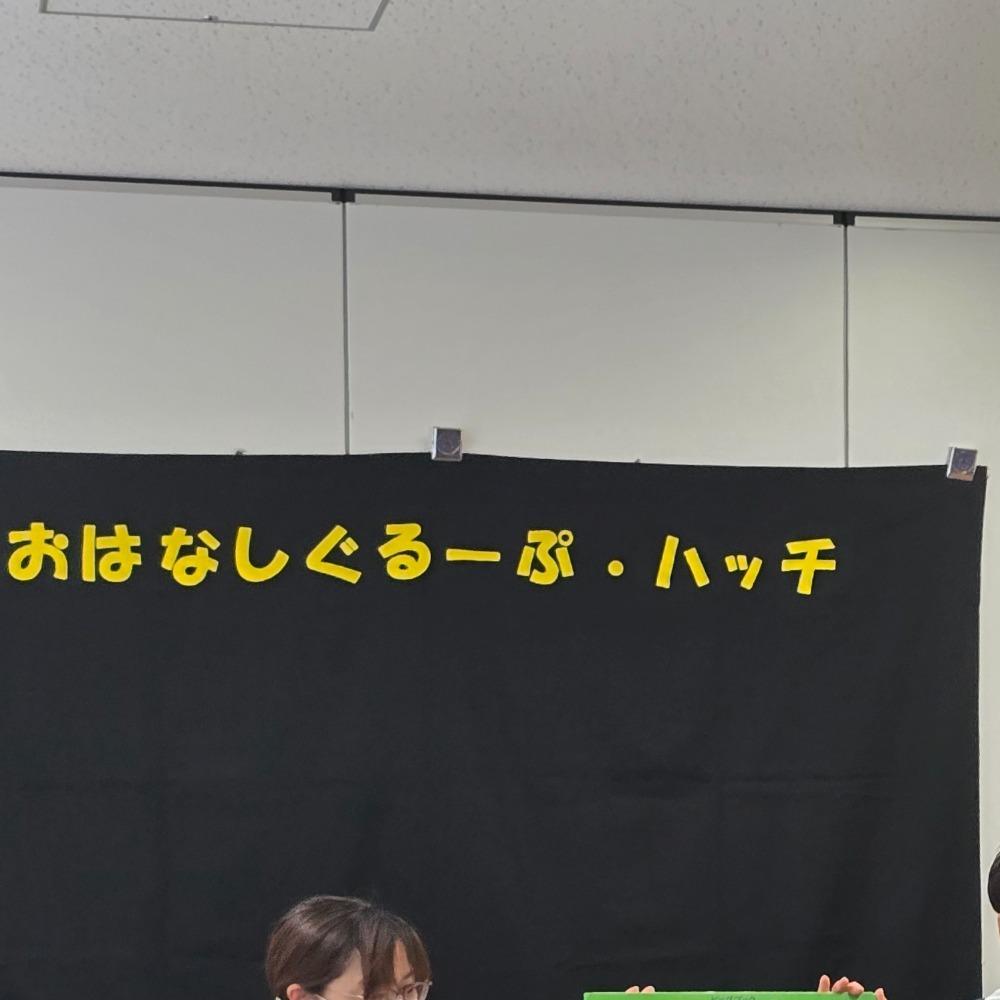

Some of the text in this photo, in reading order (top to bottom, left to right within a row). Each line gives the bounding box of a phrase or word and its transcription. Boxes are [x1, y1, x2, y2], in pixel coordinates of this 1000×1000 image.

[8, 522, 836, 595] おはなしぐるーぷ・ハッチ
